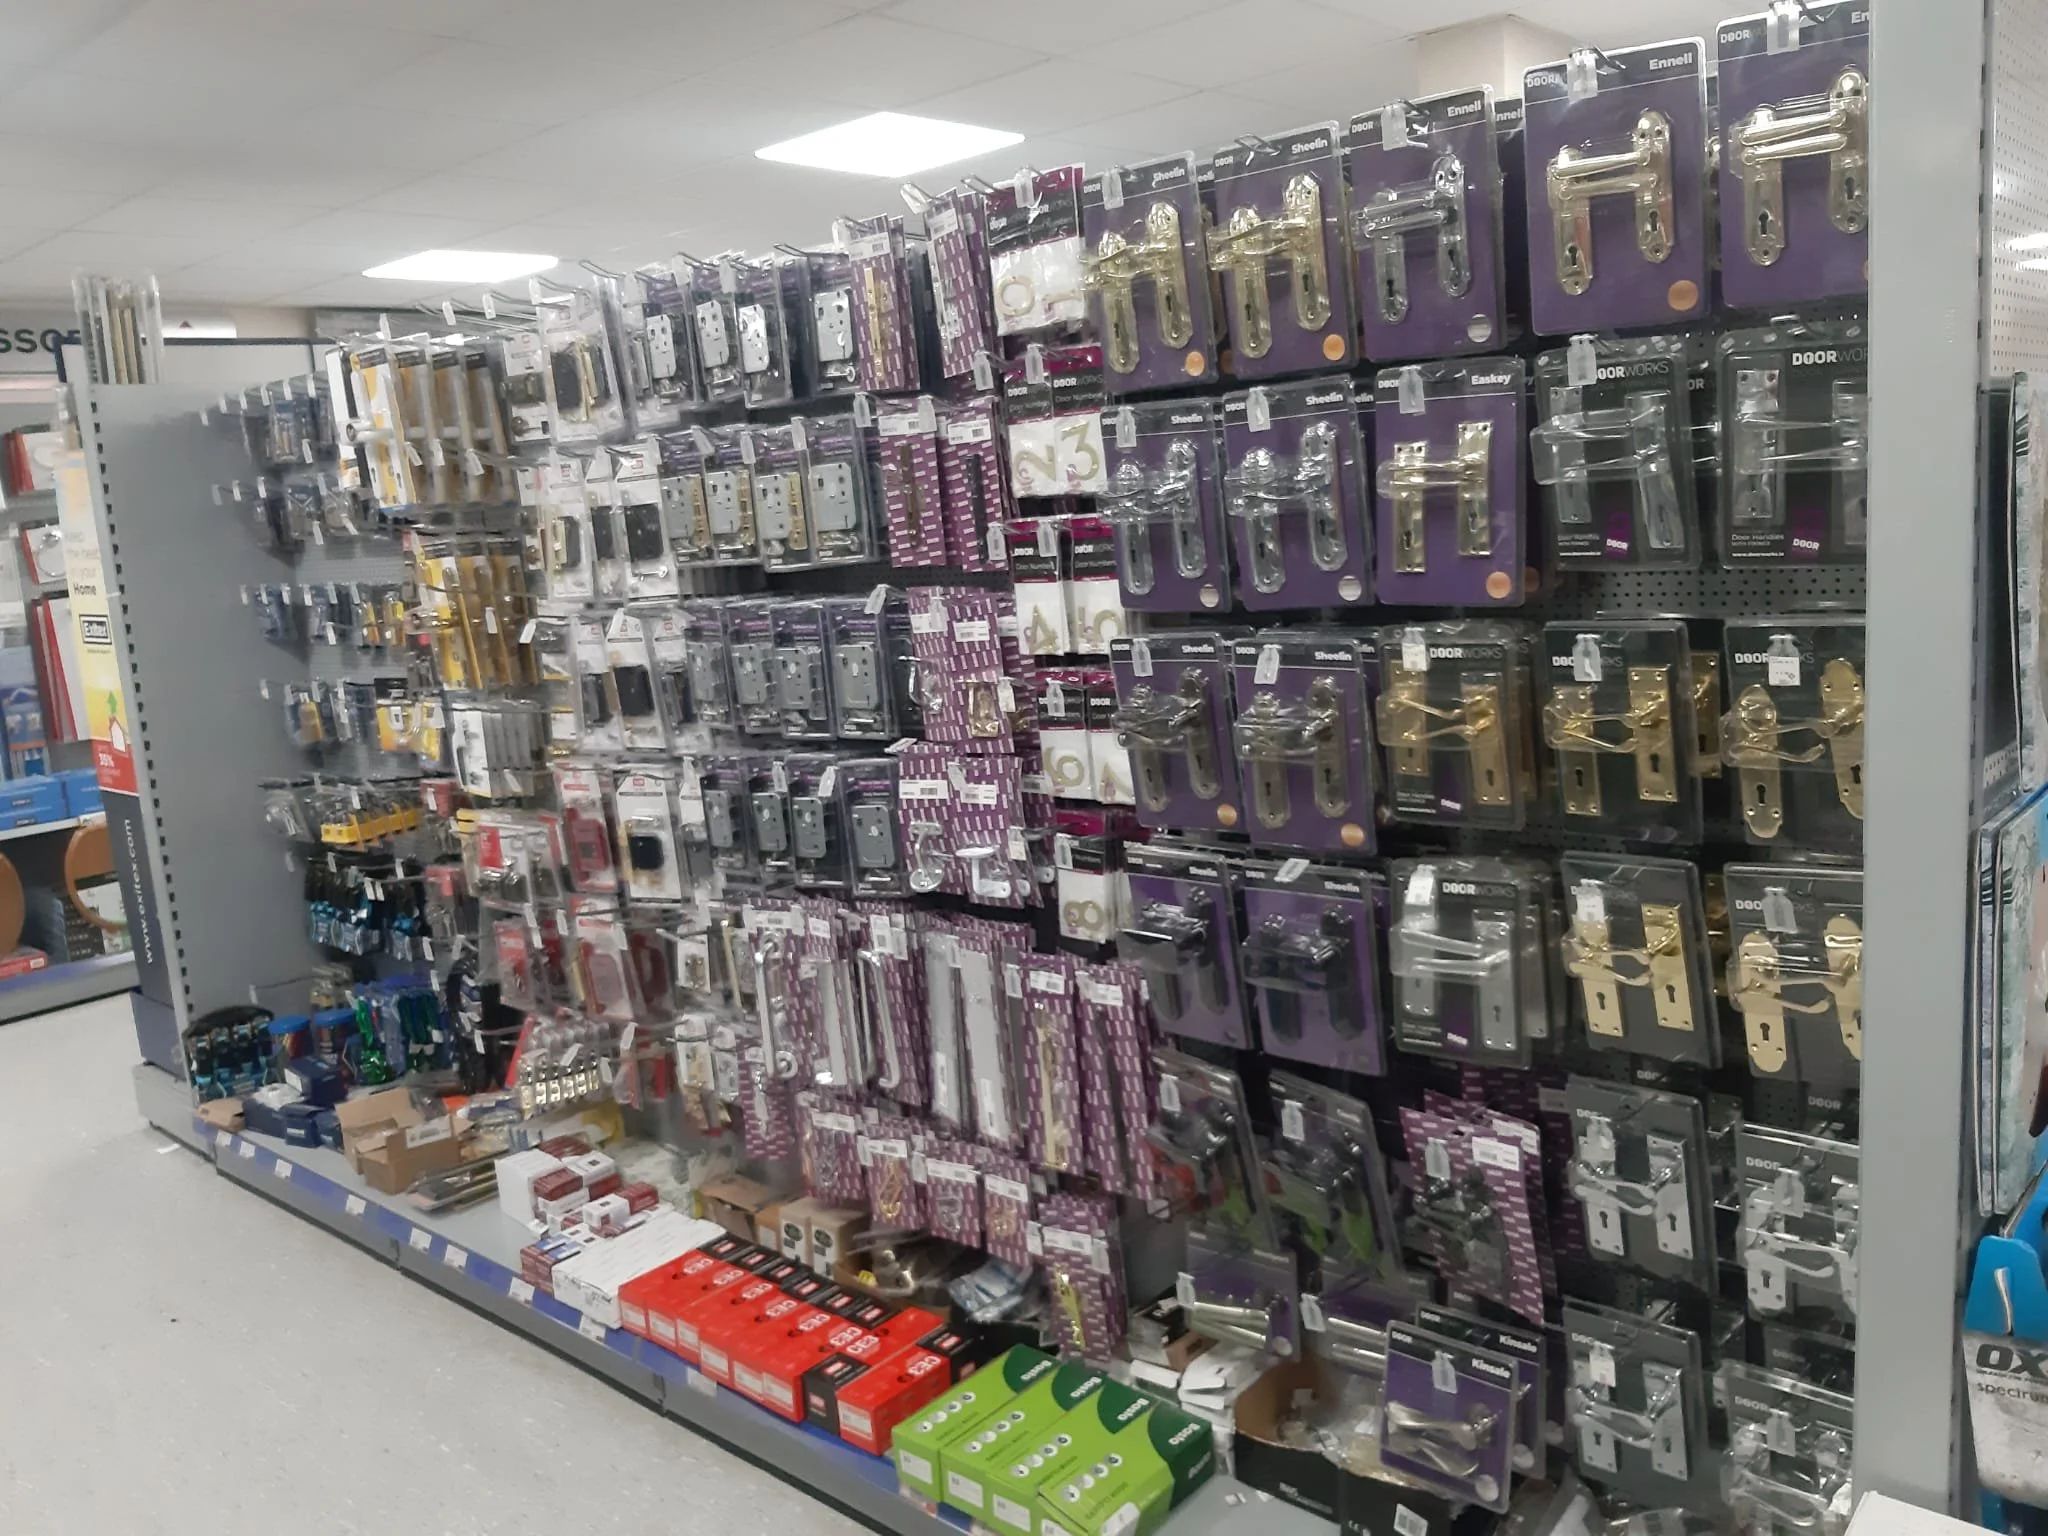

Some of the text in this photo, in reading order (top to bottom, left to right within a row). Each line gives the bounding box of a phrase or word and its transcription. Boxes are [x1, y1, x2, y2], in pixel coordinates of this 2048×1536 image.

[1649, 52, 1693, 72] Ennell
[1447, 100, 1482, 118] Ennell
[1291, 138, 1328, 155] Sheelin
[1153, 167, 1185, 183] Sheelin
[1471, 373, 1512, 386] Easkey
[1305, 392, 1343, 407] Sheelin
[1170, 413, 1203, 425] Sheelin
[1792, 538, 1820, 551] DOOR
[73, 583, 97, 597] Home
[1314, 651, 1352, 662] Sheelin
[1499, 1334, 1538, 1353] Kinsale
[1471, 1357, 1511, 1379] Kinsale
